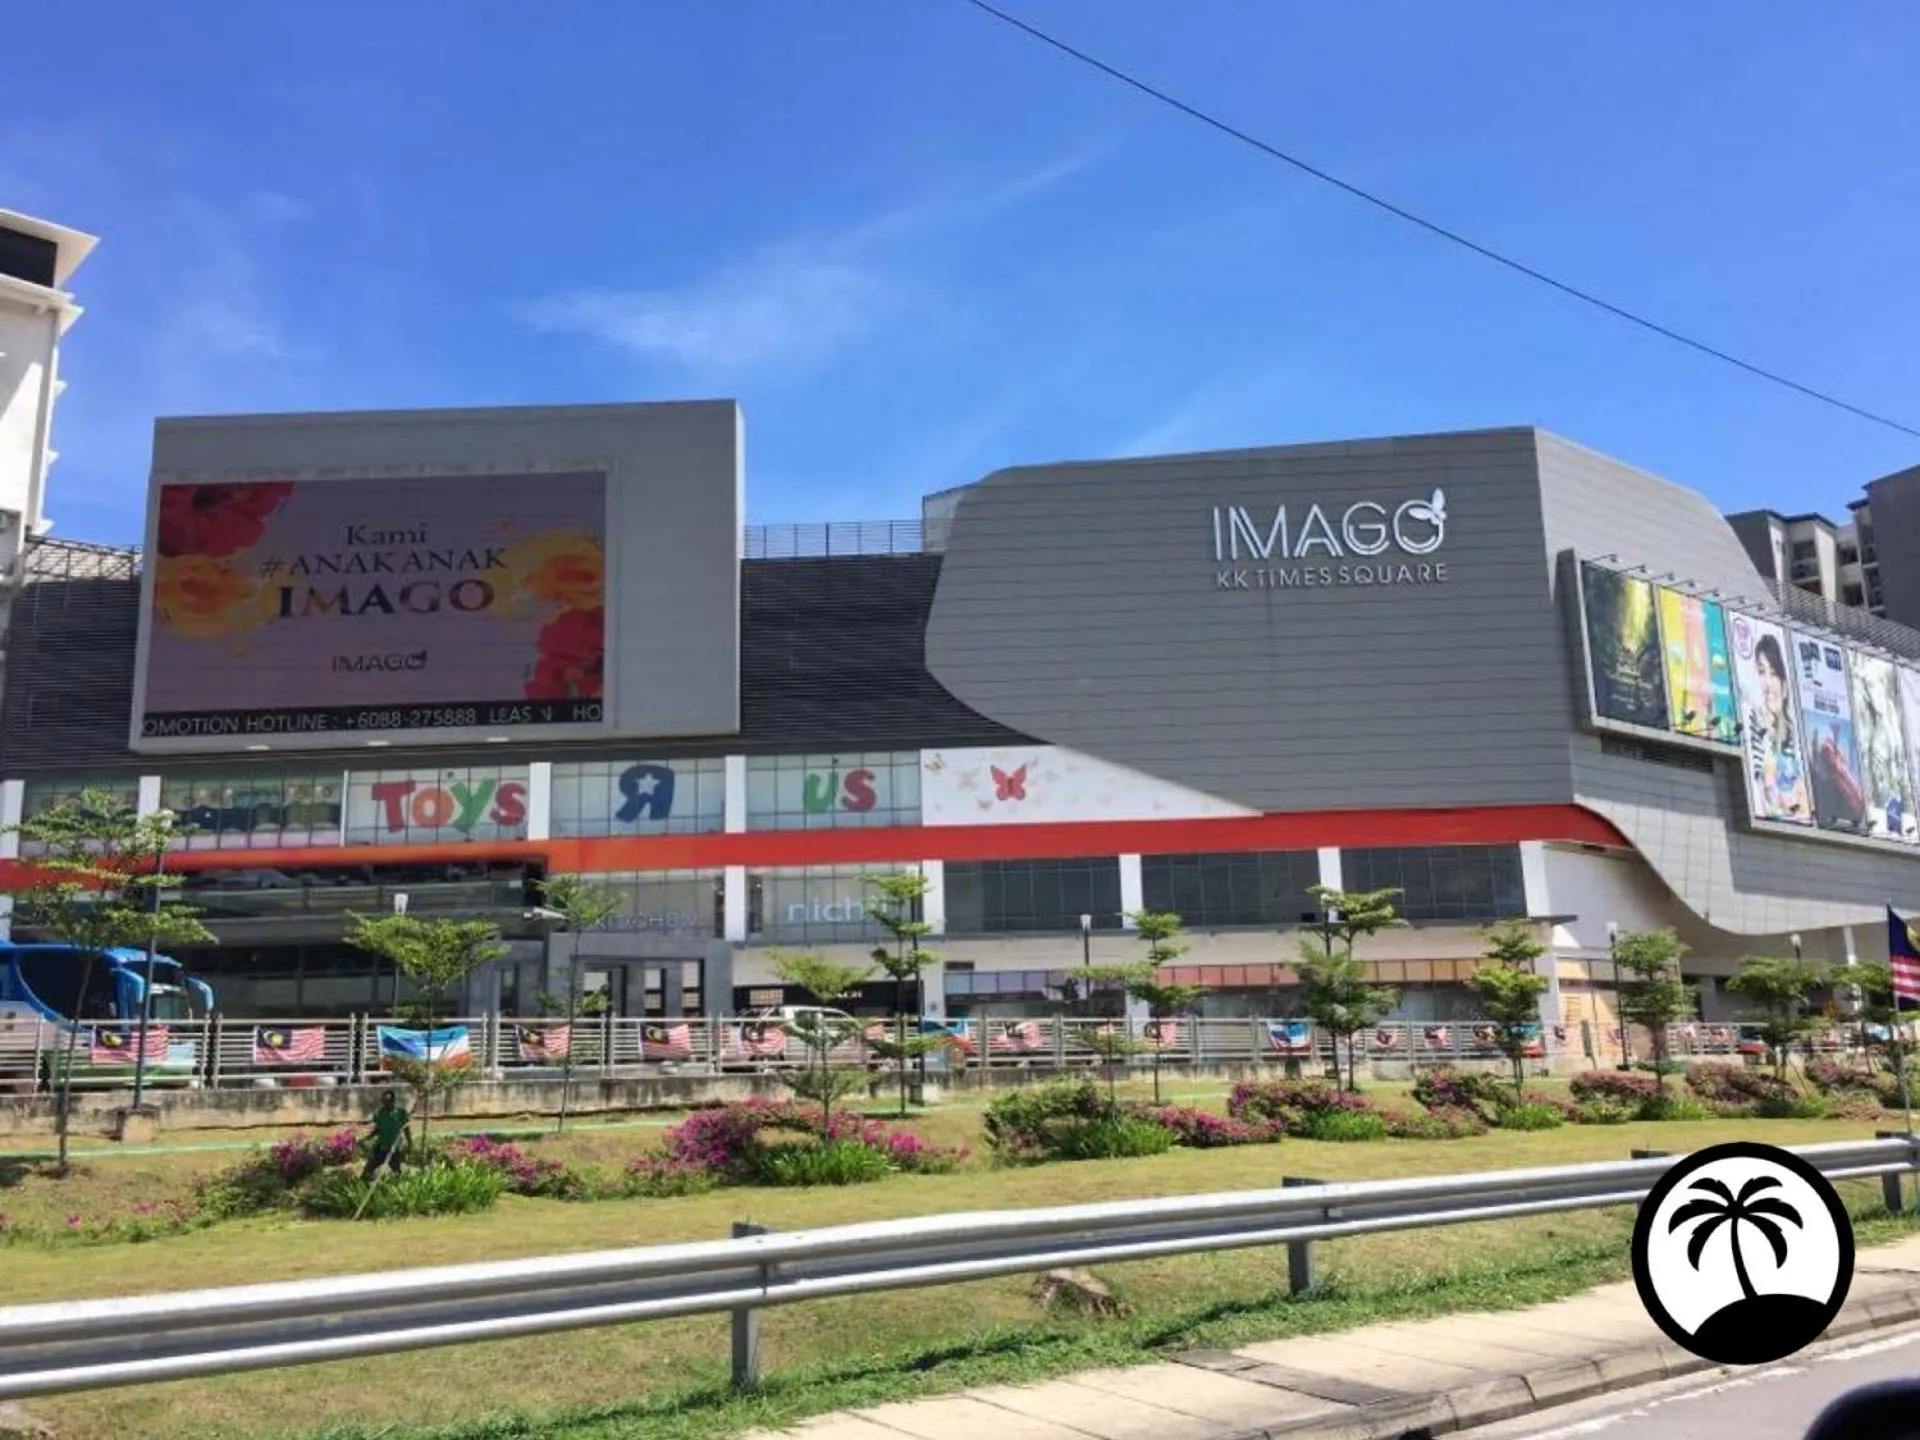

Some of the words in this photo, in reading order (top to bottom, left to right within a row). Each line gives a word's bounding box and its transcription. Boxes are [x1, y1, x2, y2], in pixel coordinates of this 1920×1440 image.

[344, 523, 428, 547] Kami
[1213, 488, 1447, 560] IMAGO
[260, 548, 506, 576] #ANAKANAK
[1216, 570, 1248, 588] KK
[1256, 567, 1331, 586] TIMES
[1339, 563, 1449, 584] SQUARE
[278, 578, 494, 619] IMAGO
[332, 650, 427, 674] IMAGO
[247, 713, 327, 733] HOTLINE
